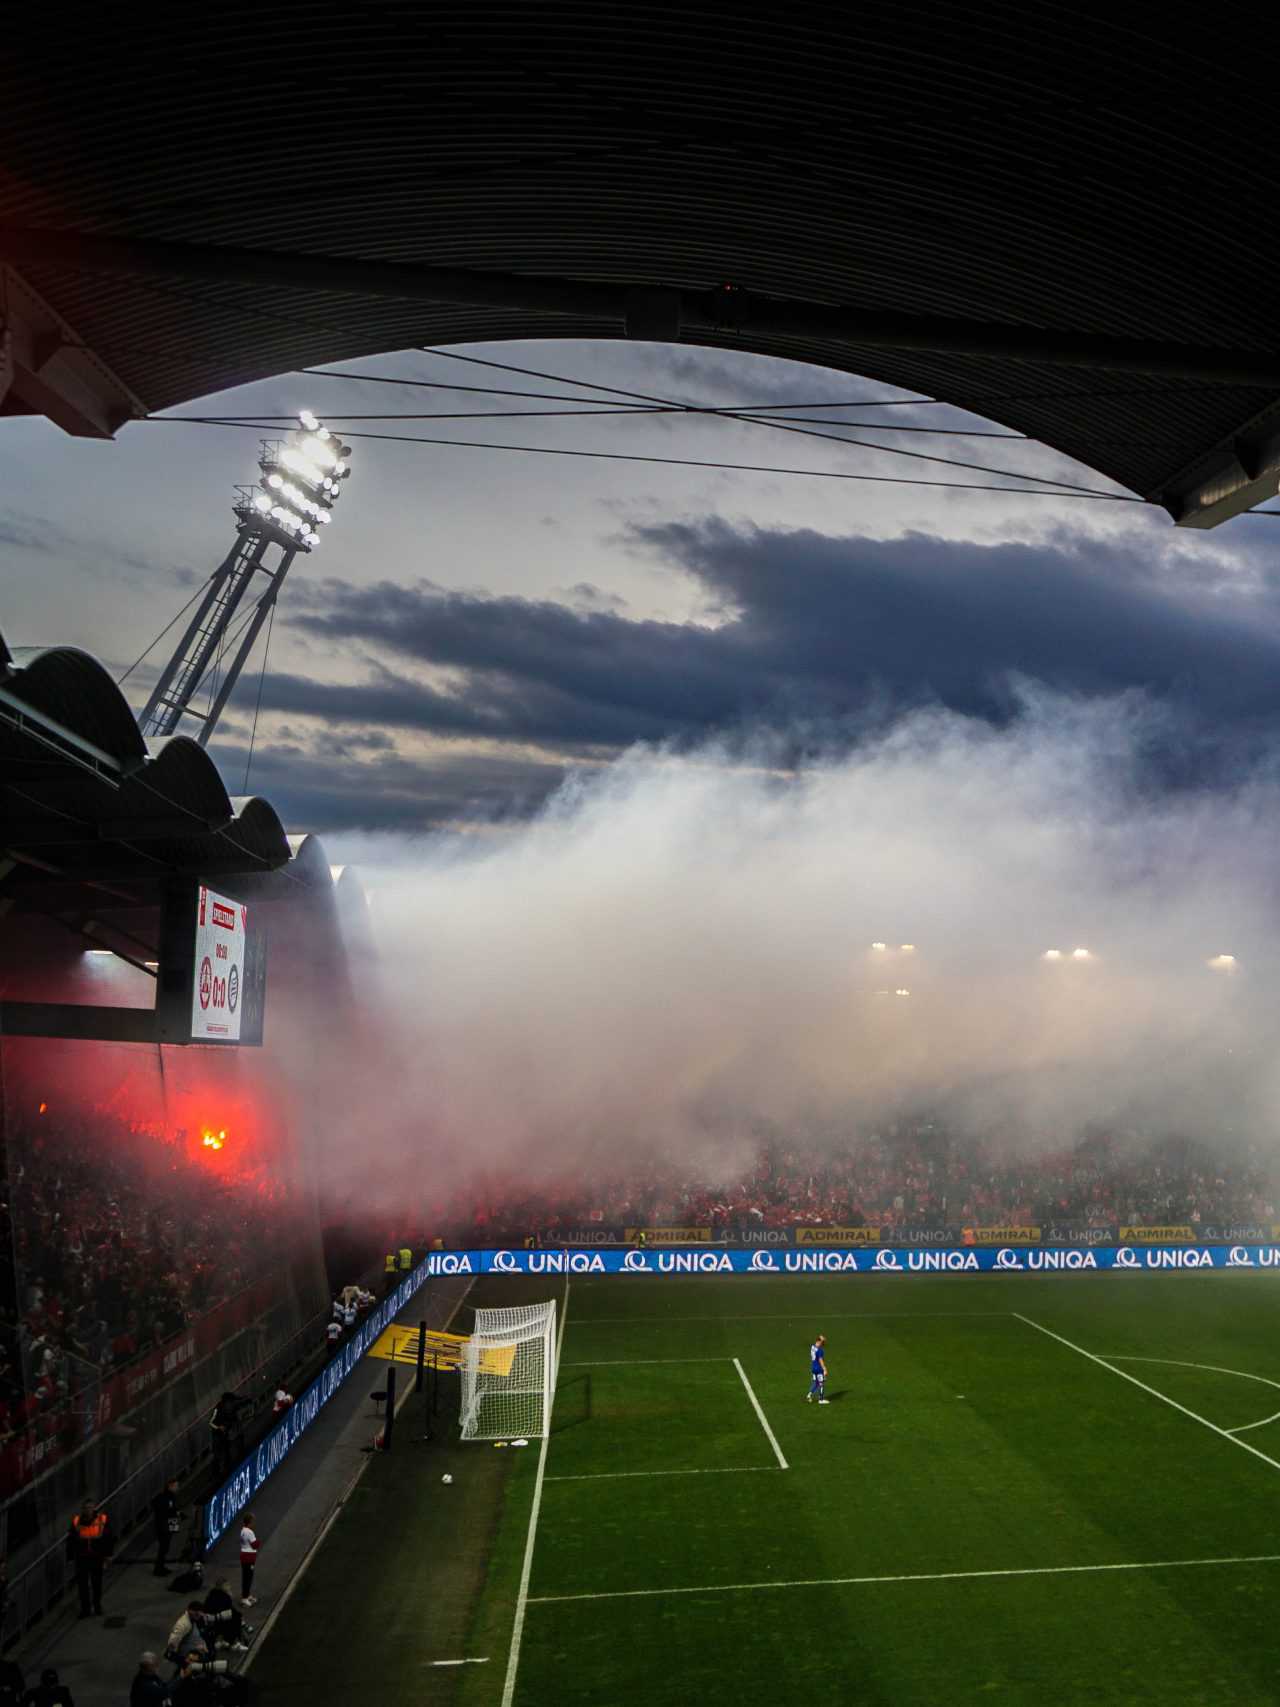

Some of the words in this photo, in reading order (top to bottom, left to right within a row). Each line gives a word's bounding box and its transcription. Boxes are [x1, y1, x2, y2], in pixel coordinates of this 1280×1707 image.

[212, 975, 226, 1008] 0:0
[568, 1231, 617, 1242] UNIQA
[741, 1230, 789, 1242] UNIQA
[802, 1230, 876, 1242] ADMIRAL
[909, 1229, 954, 1241] UNIQA
[1068, 1229, 1113, 1241] UNIQA
[1125, 1228, 1194, 1240] ADMIRAL
[528, 1254, 606, 1273] UNIQA
[658, 1253, 734, 1272] UNIQA
[784, 1252, 858, 1271] UNIQA
[908, 1252, 979, 1270] UNIQA
[1028, 1251, 1097, 1269] UNIQA
[1146, 1250, 1214, 1268] UNIQA
